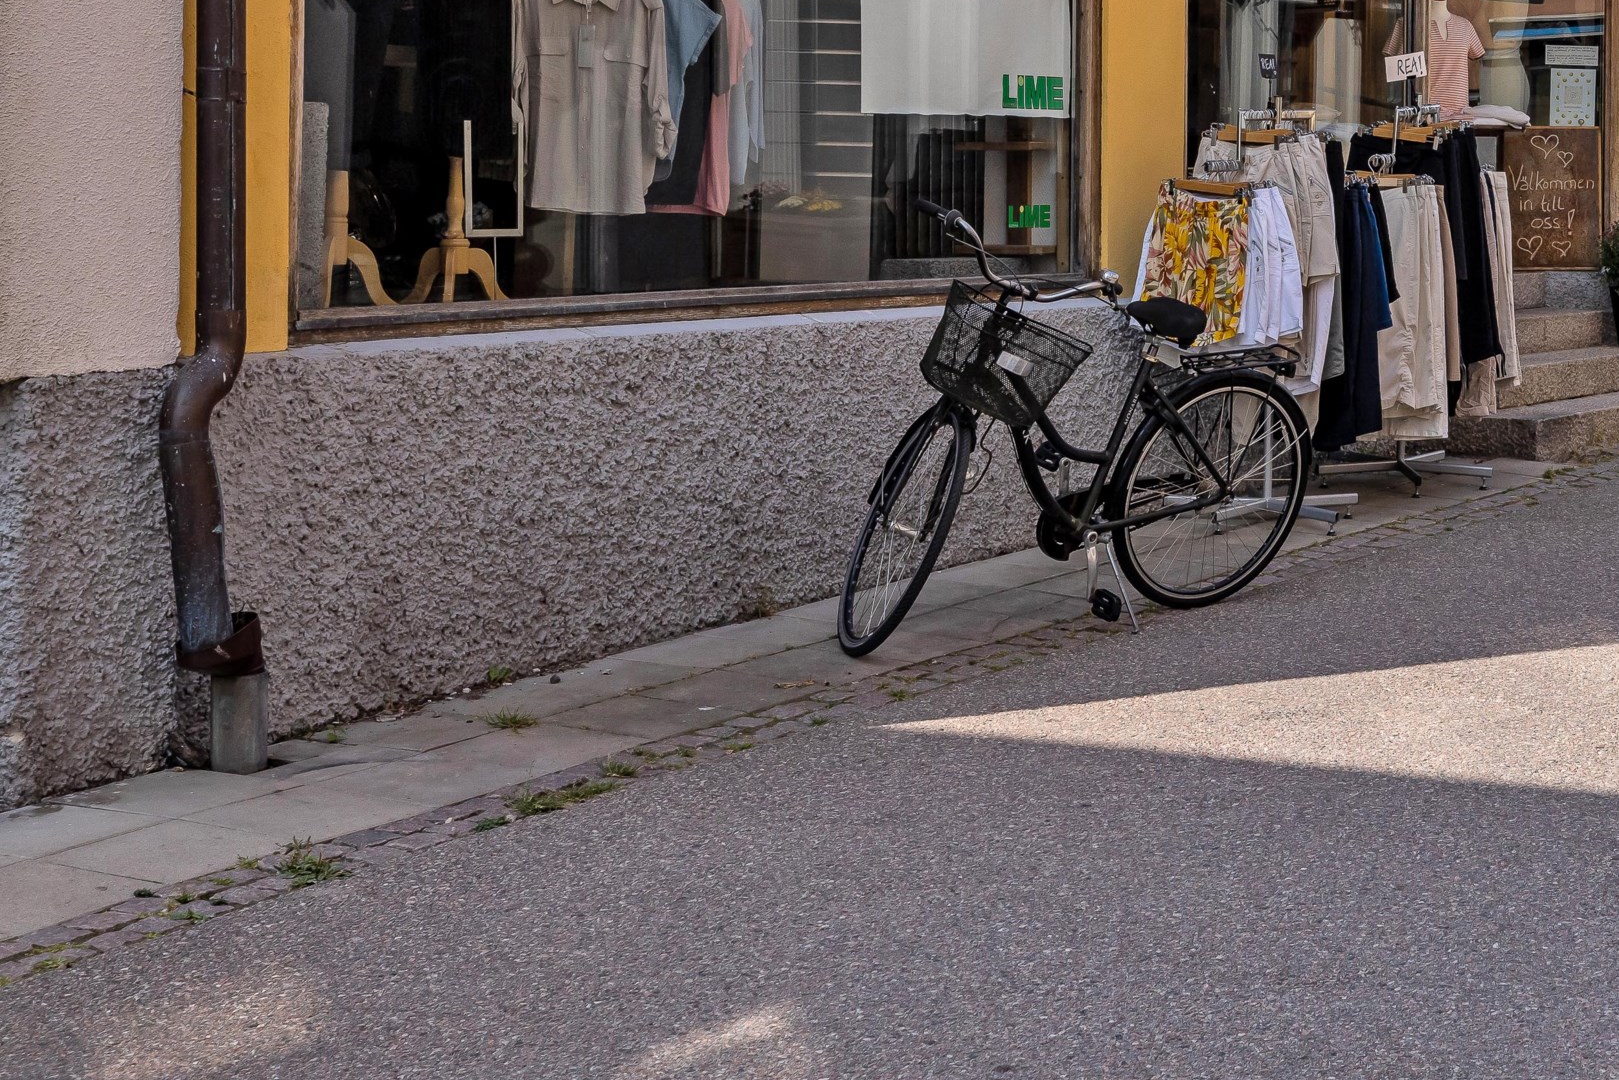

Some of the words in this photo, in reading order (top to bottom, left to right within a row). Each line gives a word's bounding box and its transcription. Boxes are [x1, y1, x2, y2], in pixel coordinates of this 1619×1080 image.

[1397, 55, 1424, 76] REA!
[1508, 164, 1595, 191] Välkommen
[1519, 196, 1533, 211] in
[1540, 196, 1565, 212] till
